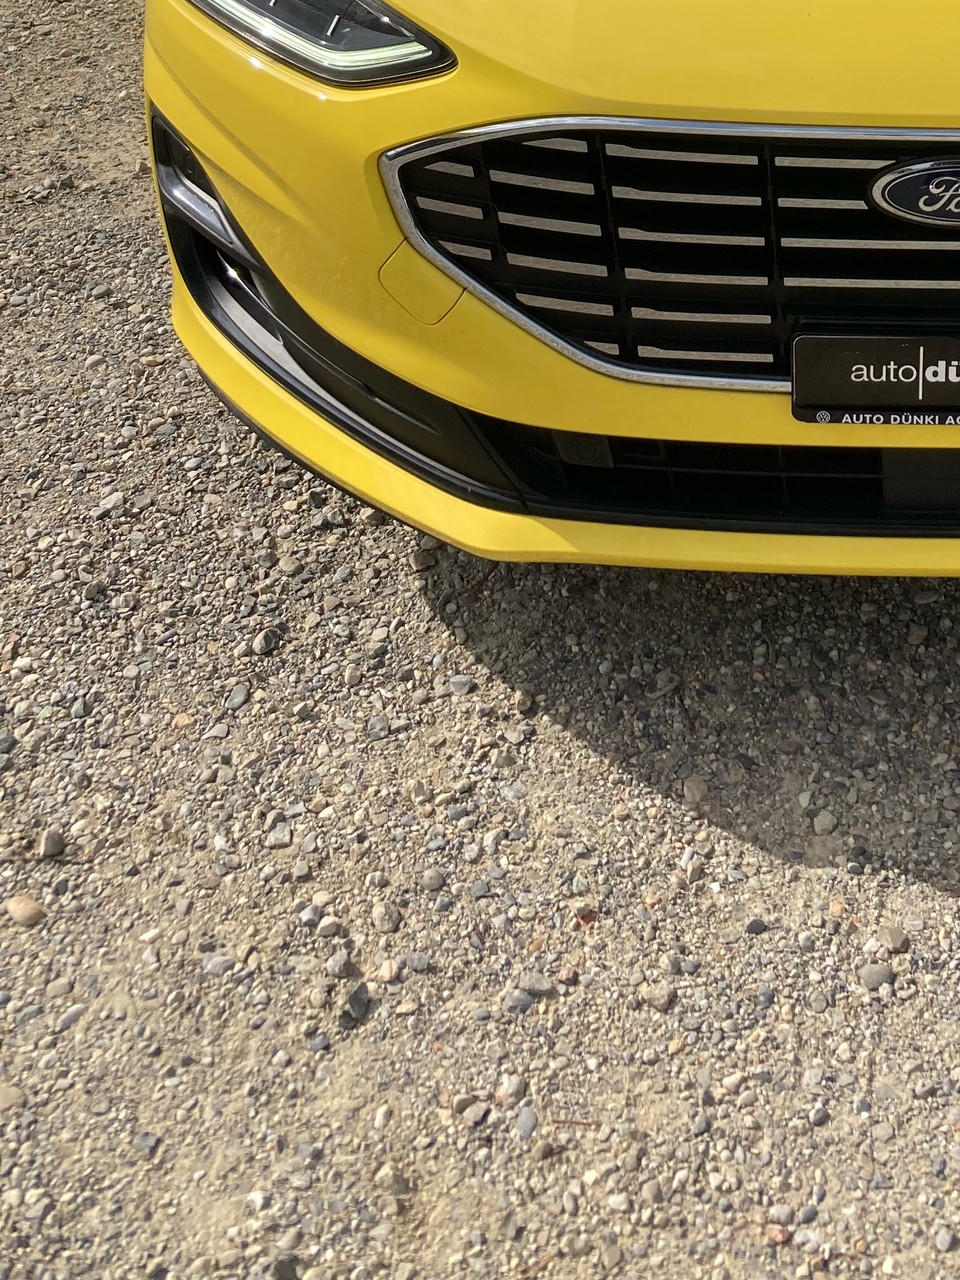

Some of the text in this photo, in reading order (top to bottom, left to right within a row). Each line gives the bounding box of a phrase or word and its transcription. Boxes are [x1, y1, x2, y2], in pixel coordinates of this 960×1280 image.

[850, 361, 917, 382] auto
[842, 413, 884, 425] AUTO
[890, 412, 939, 425] DÜNKI
